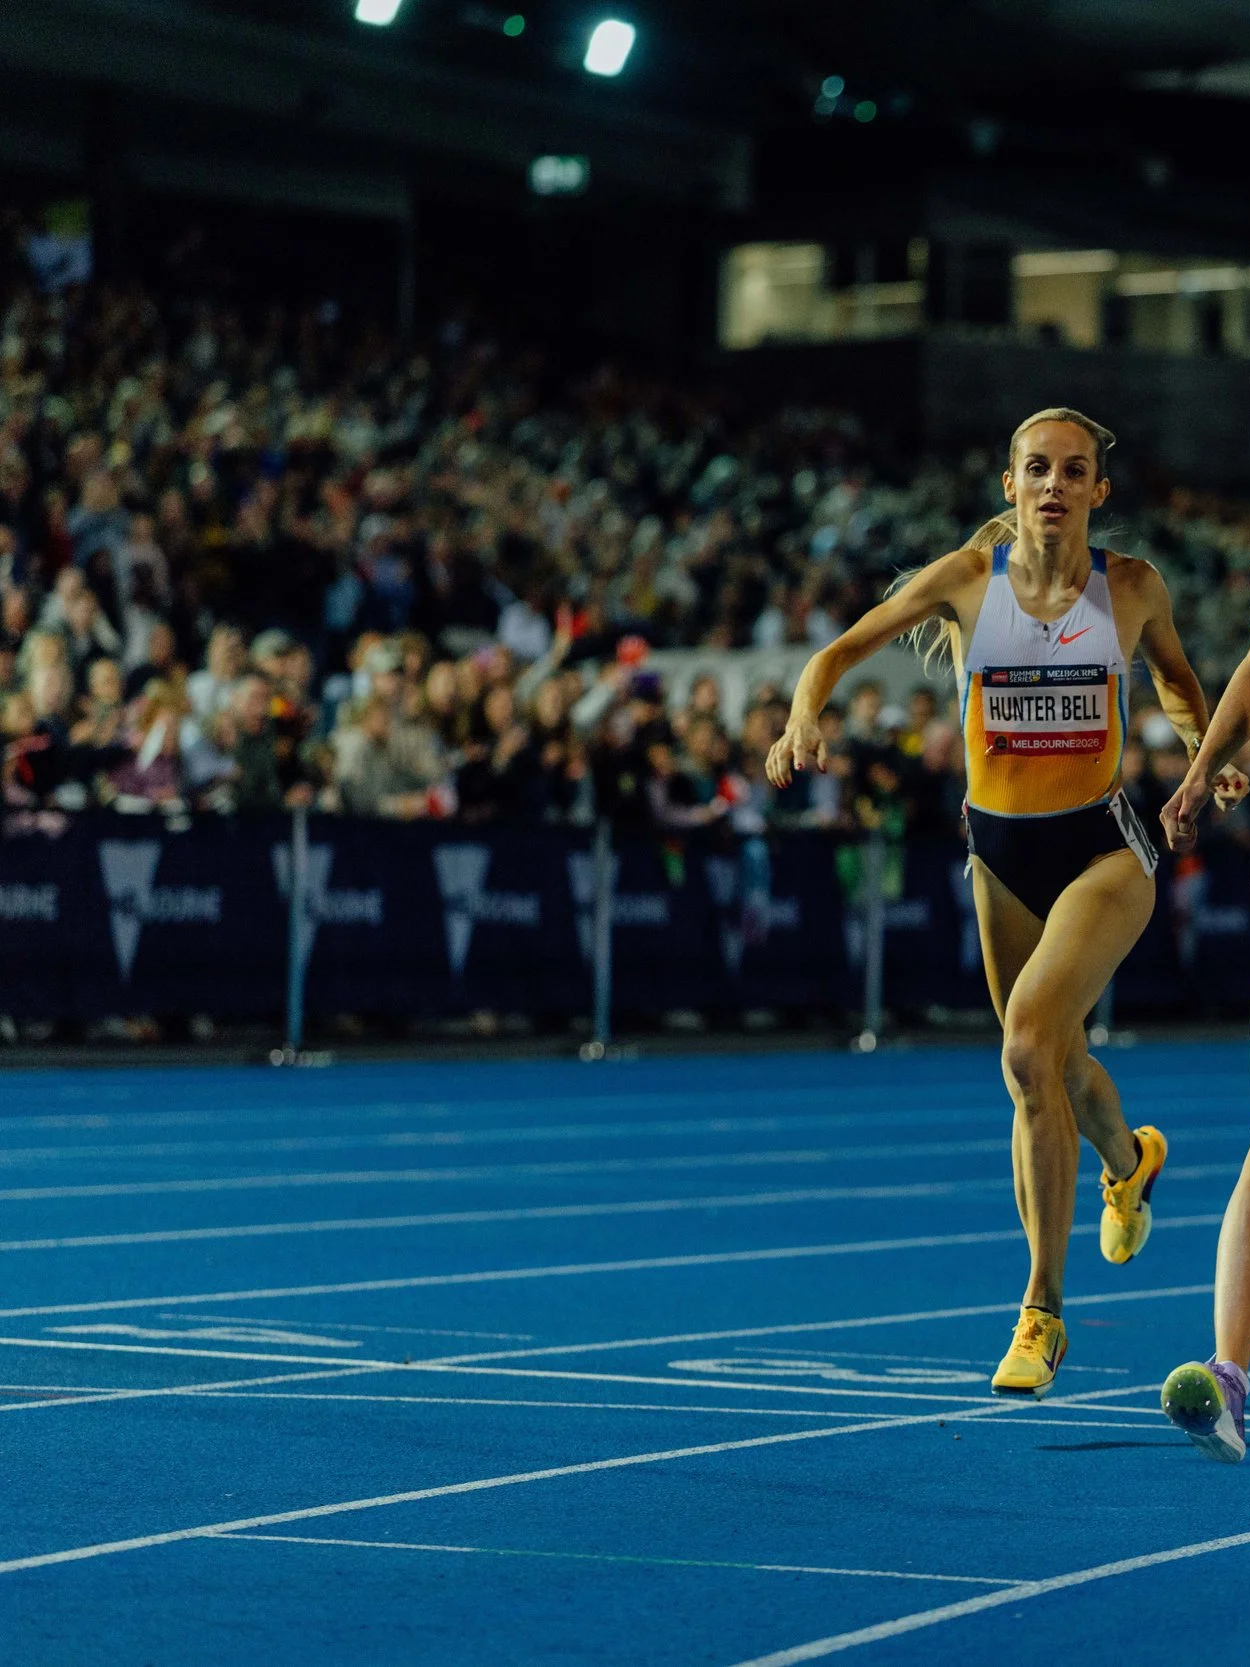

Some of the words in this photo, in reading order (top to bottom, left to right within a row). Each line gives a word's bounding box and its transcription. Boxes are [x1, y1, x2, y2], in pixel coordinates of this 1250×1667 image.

[1046, 668, 1099, 678] MELBOURNE
[990, 696, 1056, 722] HUNTER
[1062, 694, 1101, 721] BELL
[1012, 738, 1100, 749] MELBOURNE2026
